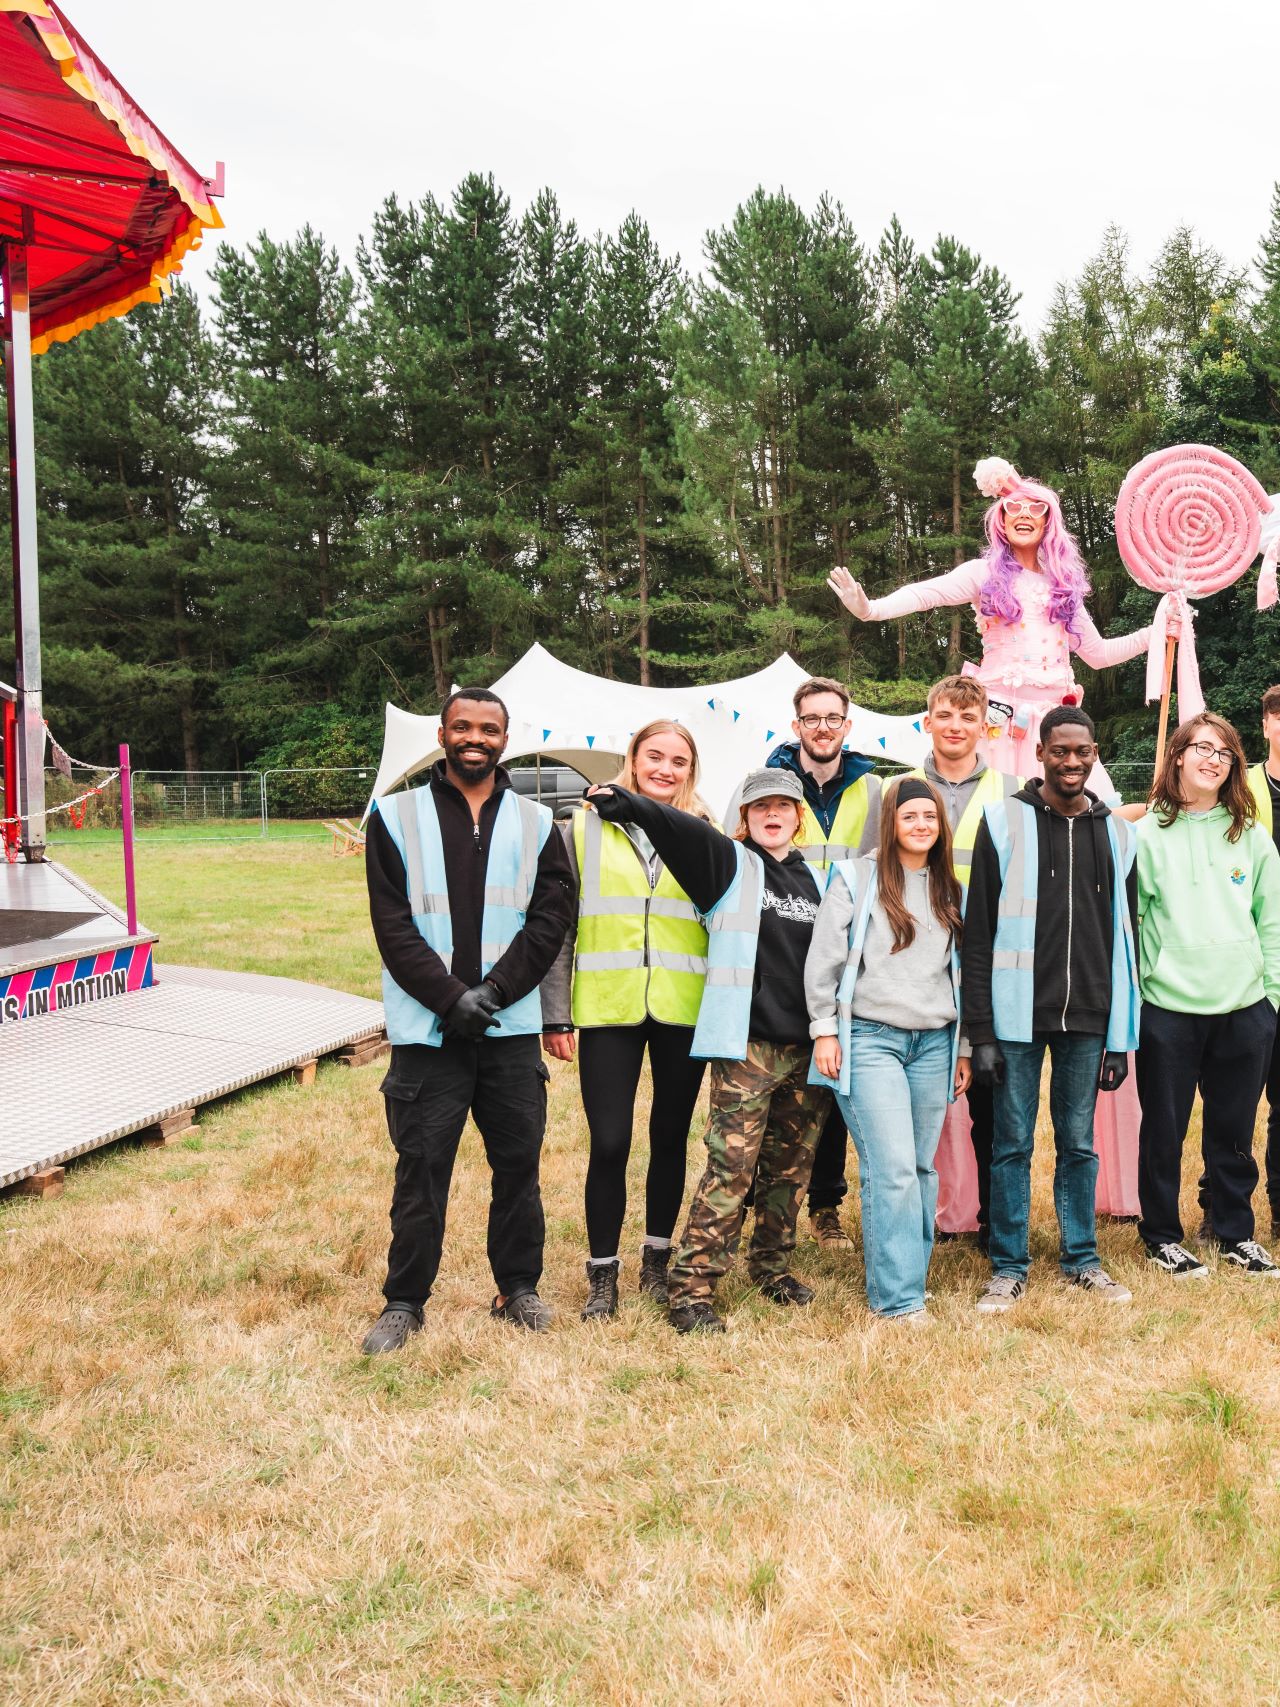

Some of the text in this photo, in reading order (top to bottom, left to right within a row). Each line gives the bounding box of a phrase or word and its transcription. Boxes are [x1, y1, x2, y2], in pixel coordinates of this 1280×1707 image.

[0, 969, 127, 1023] S IN MOTION
